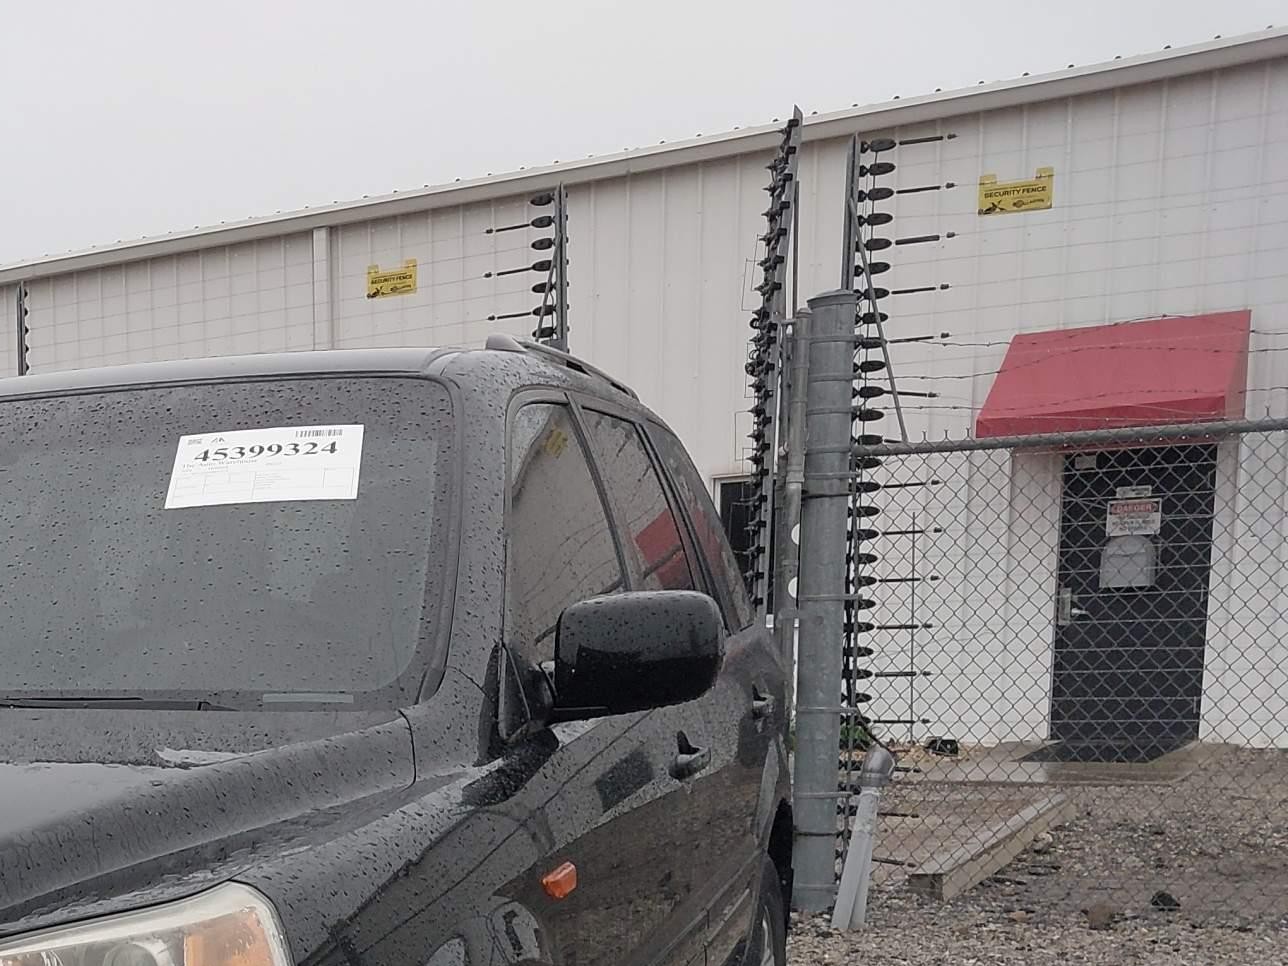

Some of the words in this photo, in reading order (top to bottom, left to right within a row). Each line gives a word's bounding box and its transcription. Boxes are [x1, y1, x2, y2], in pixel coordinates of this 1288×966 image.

[983, 188, 1021, 199] SECURITY
[1022, 185, 1047, 194] FENCE
[193, 440, 339, 463] 45399324
